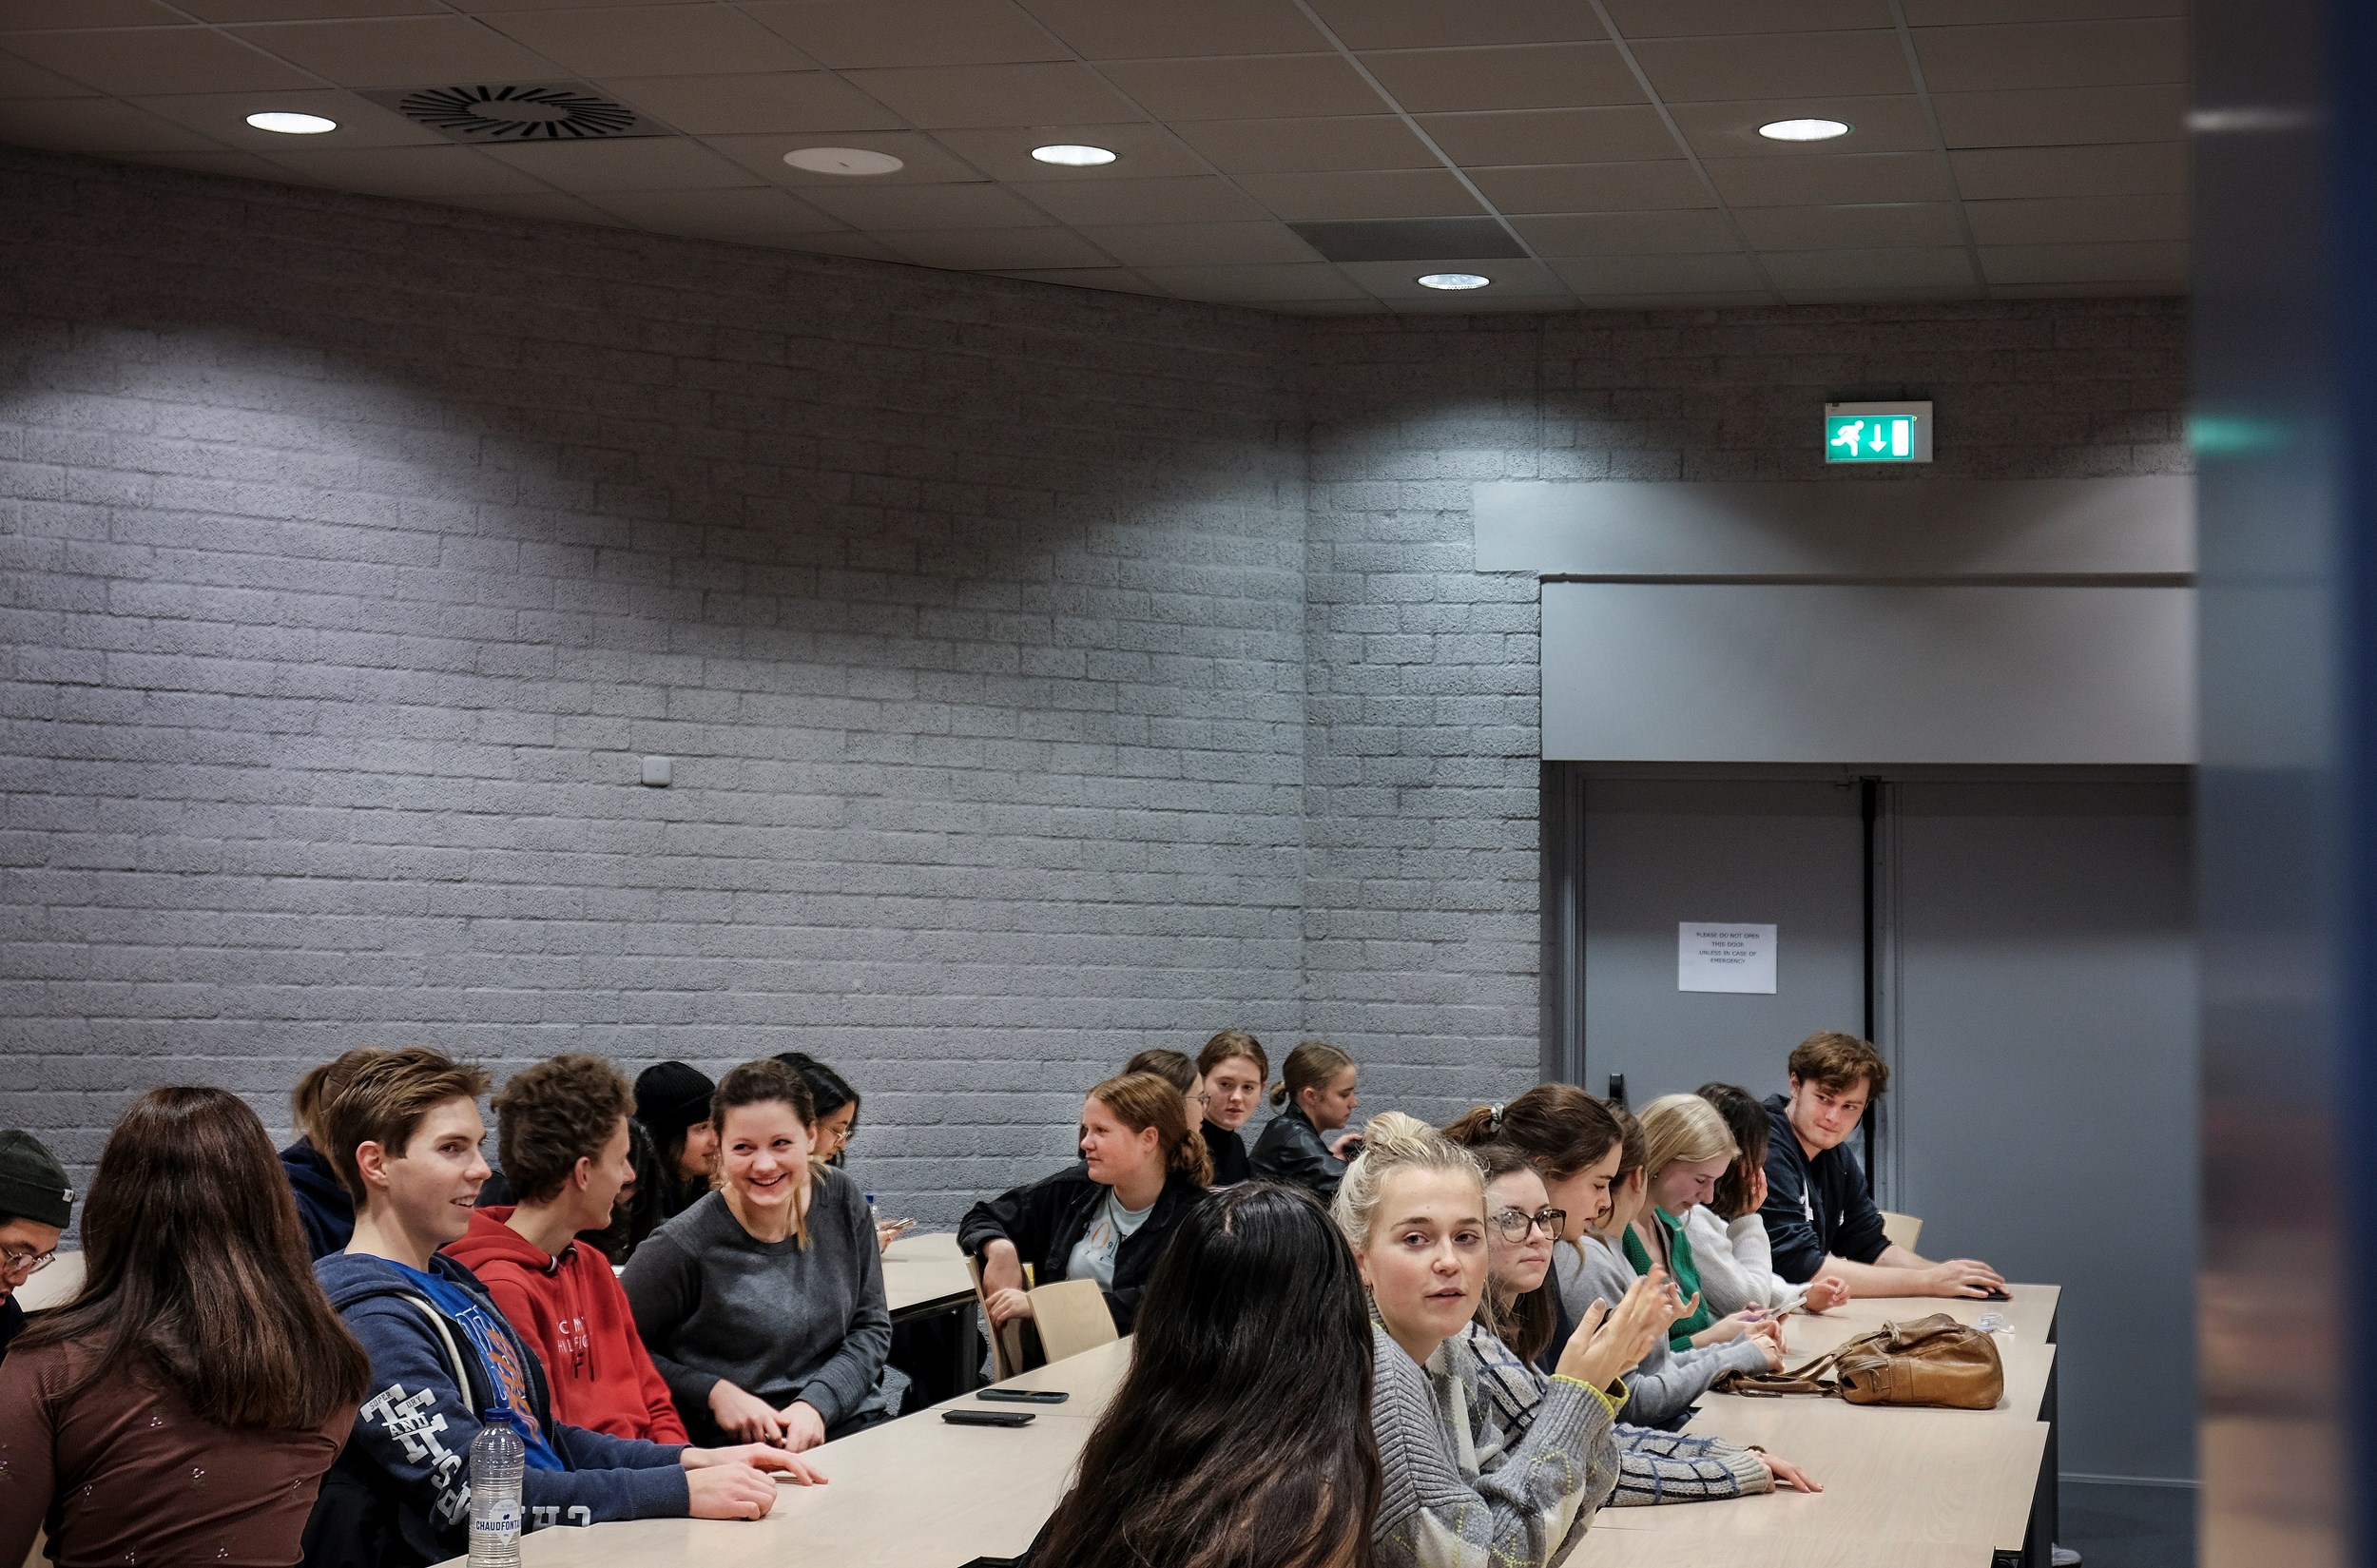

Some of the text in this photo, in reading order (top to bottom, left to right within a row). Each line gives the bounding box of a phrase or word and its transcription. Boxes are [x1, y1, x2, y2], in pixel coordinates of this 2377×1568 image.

[369, 1391, 392, 1409] SUPER
[406, 1395, 422, 1408] DRY
[390, 1416, 429, 1437] AND
